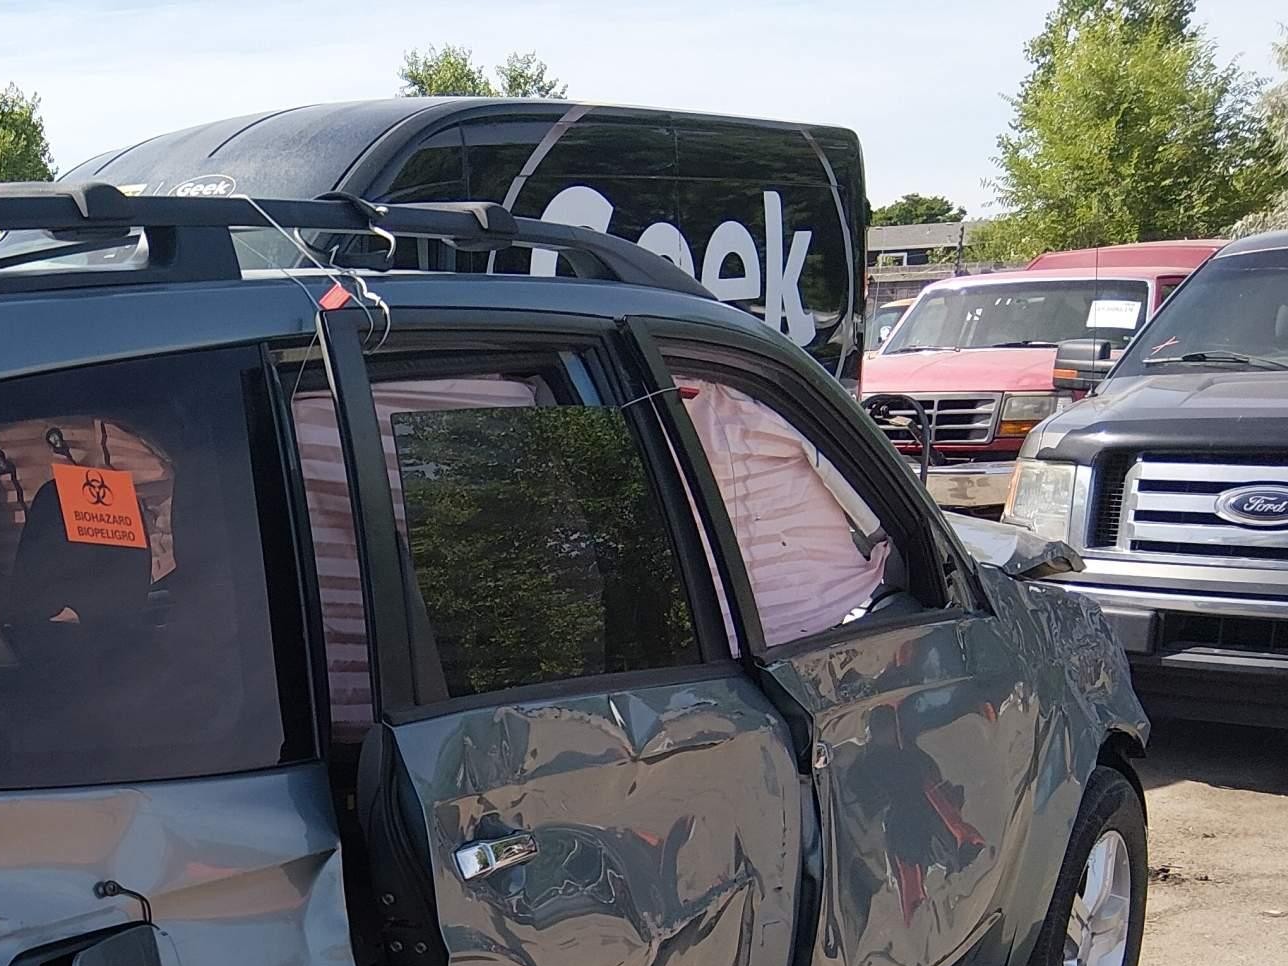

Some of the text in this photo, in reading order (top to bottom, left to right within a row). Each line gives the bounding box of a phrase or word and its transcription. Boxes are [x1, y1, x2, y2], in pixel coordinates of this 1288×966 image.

[176, 181, 231, 196] Geek
[1243, 495, 1287, 513] Ford
[73, 510, 133, 527] BIOHAZARD
[77, 526, 136, 542] BIOPELIGRO
